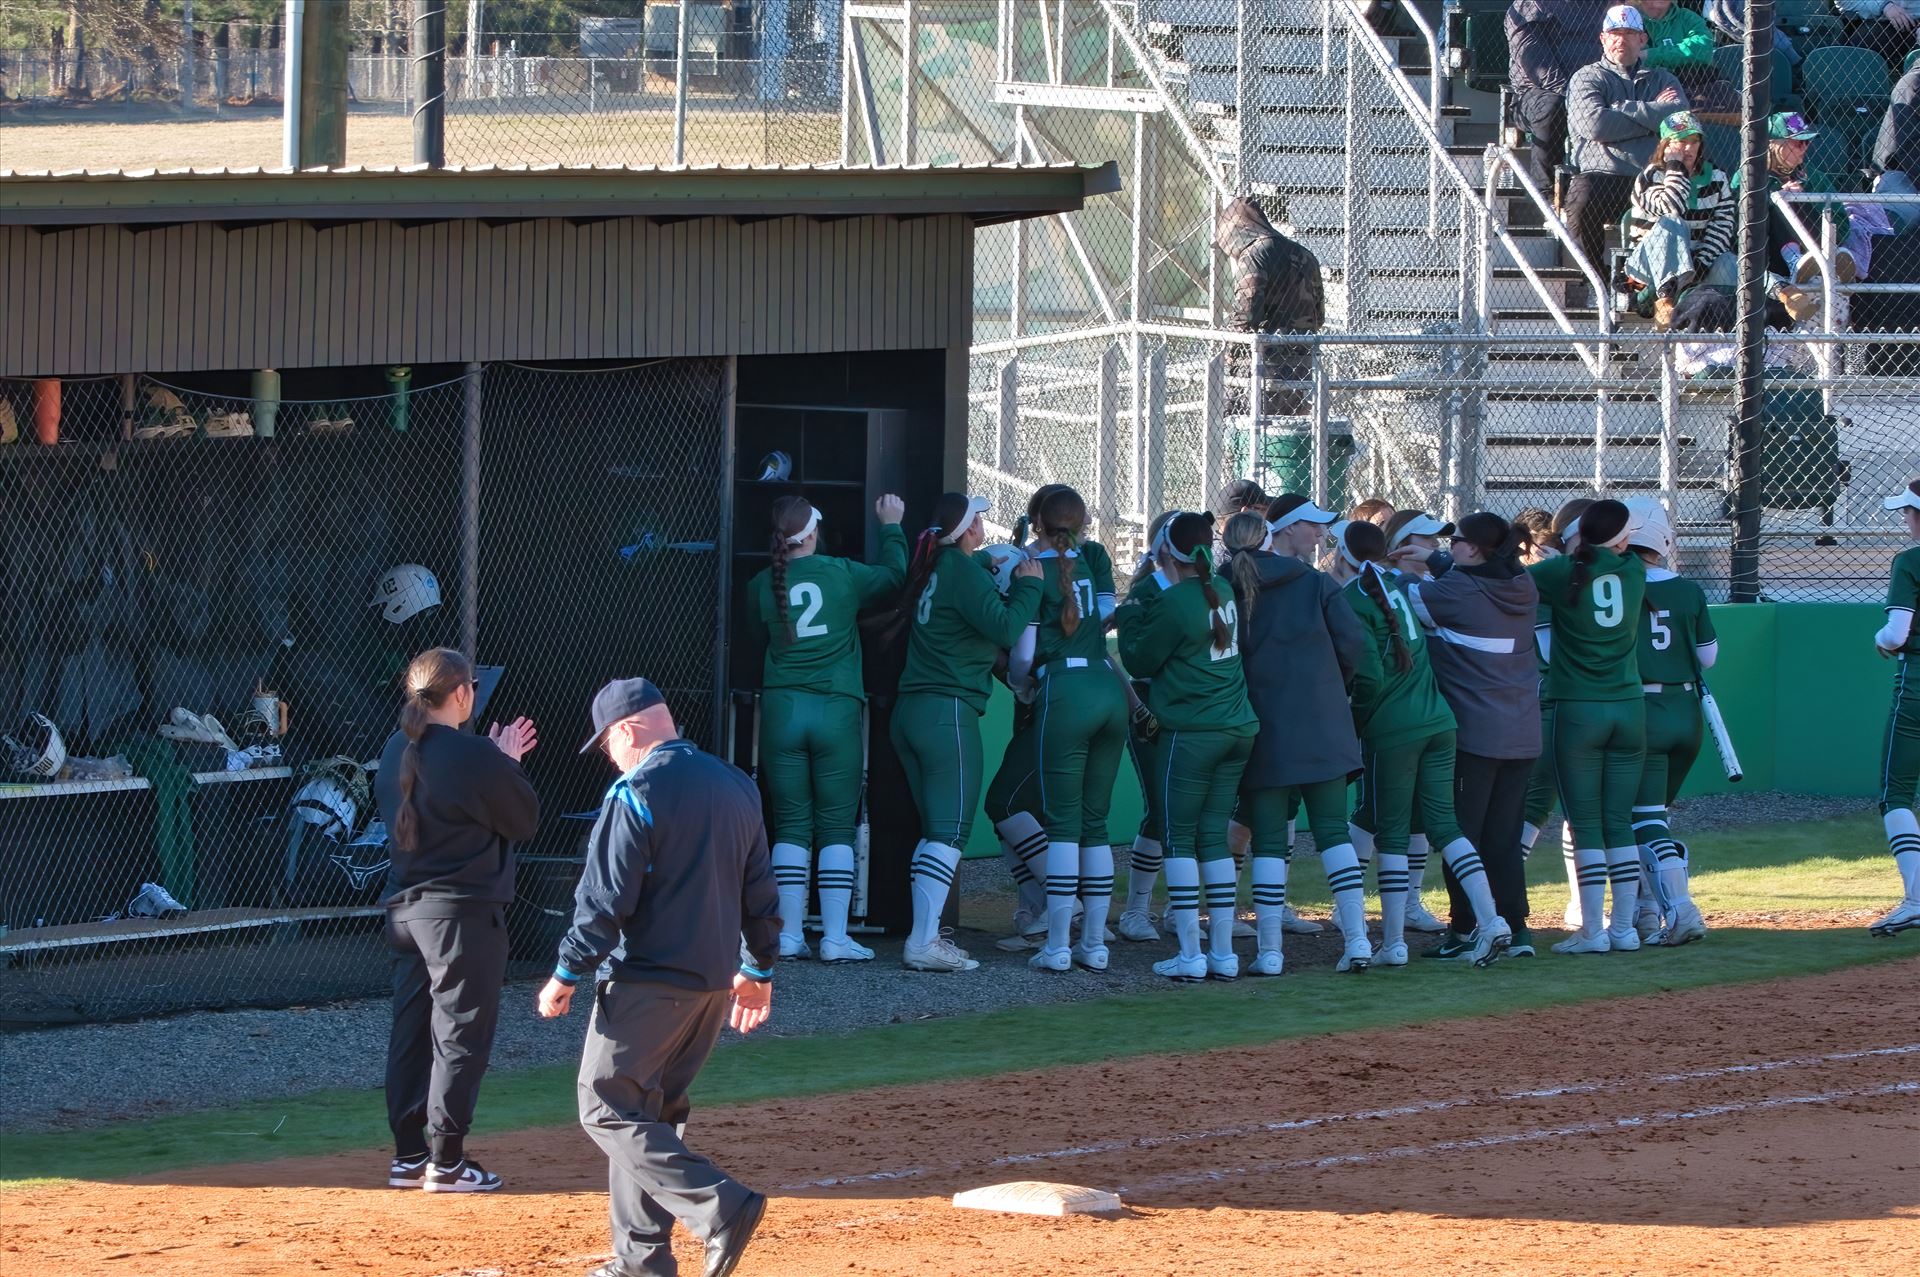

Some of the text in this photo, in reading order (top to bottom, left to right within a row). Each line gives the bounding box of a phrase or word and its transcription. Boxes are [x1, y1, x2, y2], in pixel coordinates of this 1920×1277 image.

[789, 581, 828, 638] 2
[917, 571, 938, 625] 8
[1592, 573, 1624, 628] 9
[1650, 609, 1671, 651] 5
